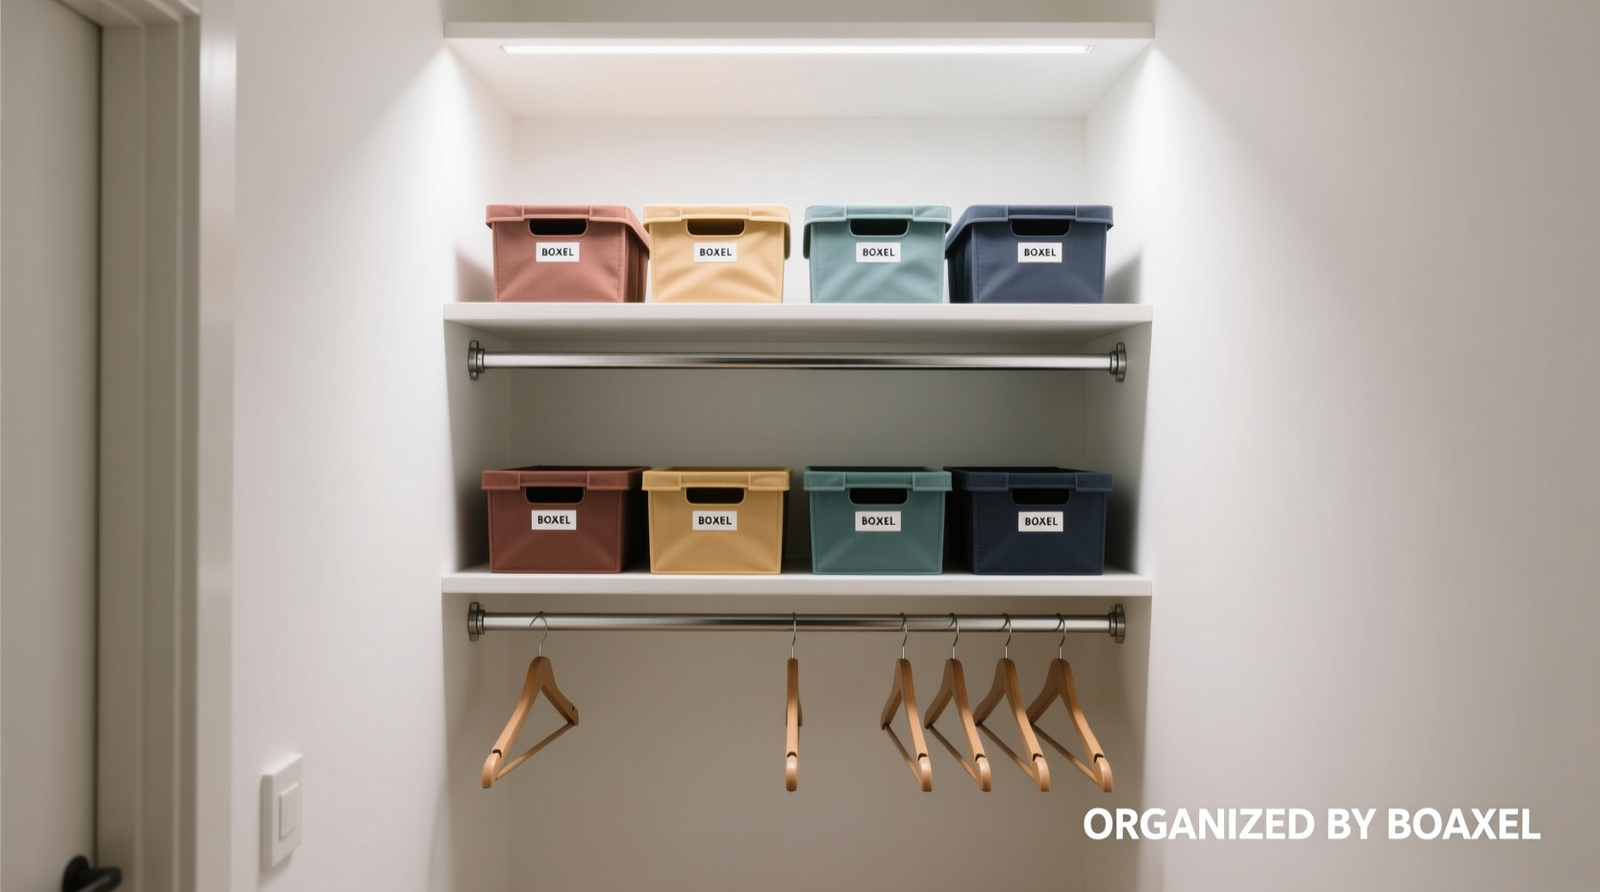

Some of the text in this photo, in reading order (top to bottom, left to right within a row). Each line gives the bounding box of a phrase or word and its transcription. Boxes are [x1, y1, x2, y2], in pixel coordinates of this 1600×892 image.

[541, 247, 574, 257] BOXEL
[699, 247, 732, 257] BOXEL
[862, 248, 895, 257] BOXEL
[1024, 248, 1057, 257] BOXEL
[537, 515, 571, 525] BOXEL
[698, 516, 732, 525] BOXEL
[861, 516, 896, 526] BOXEL
[1024, 516, 1058, 526] BOXEL
